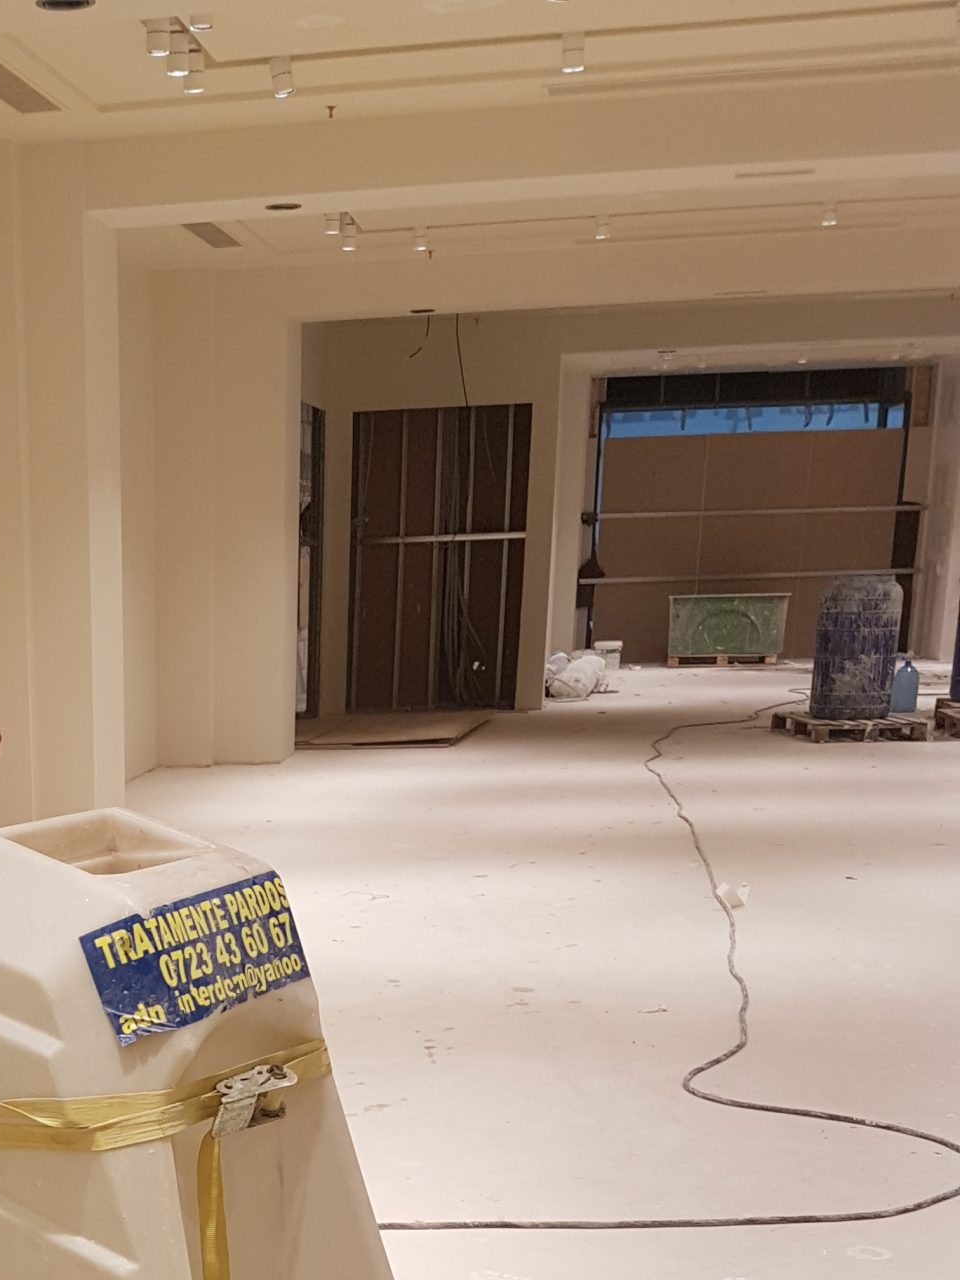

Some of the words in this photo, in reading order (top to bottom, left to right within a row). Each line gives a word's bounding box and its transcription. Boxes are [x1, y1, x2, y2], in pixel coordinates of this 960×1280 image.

[94, 897, 229, 969] TRATAMENTE
[159, 942, 213, 988] 0723
[216, 932, 242, 967] 43
[241, 922, 269, 958] 60
[268, 912, 293, 948] 67
